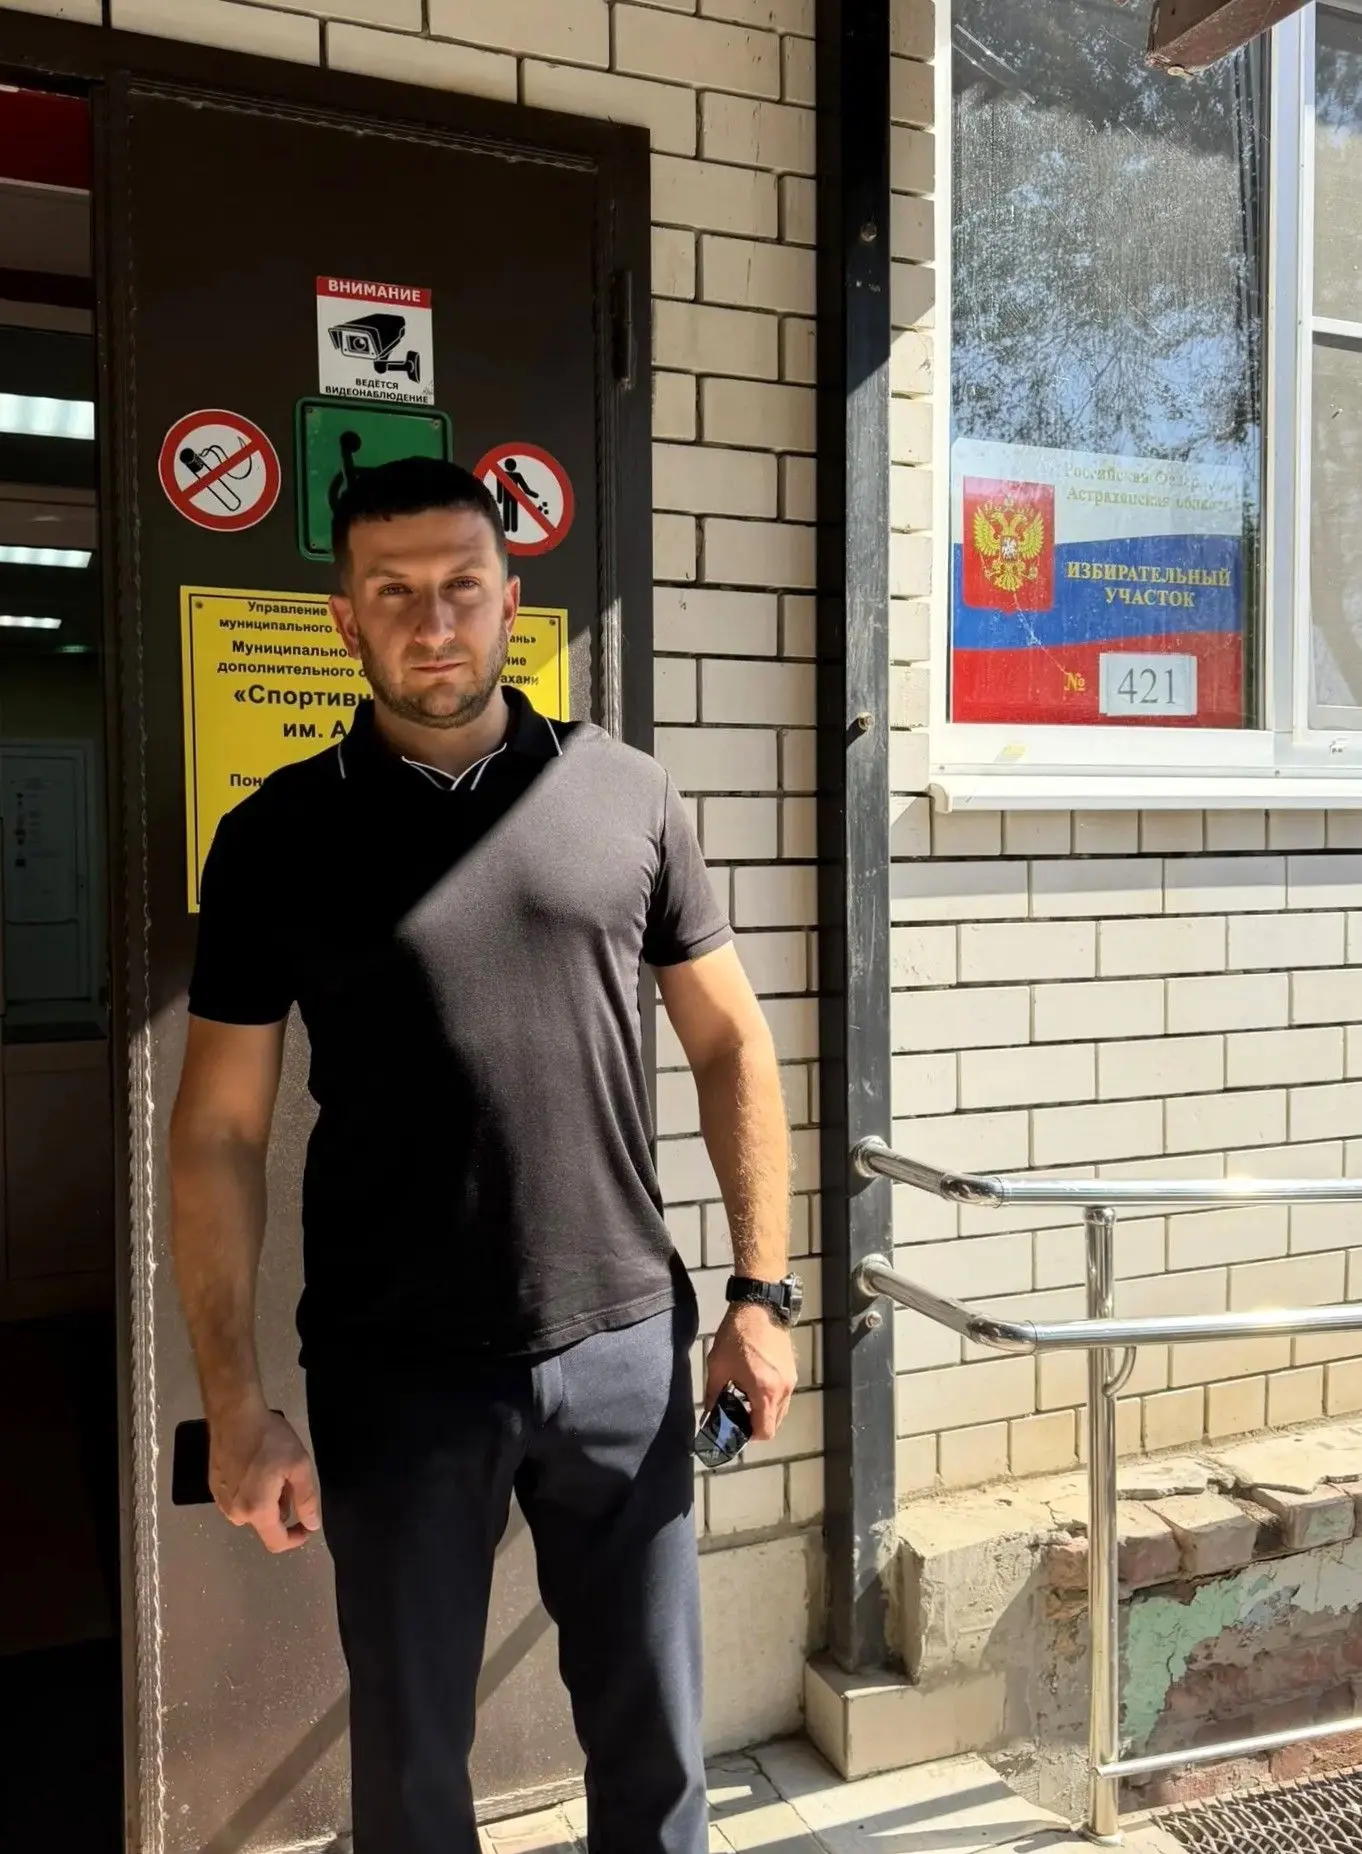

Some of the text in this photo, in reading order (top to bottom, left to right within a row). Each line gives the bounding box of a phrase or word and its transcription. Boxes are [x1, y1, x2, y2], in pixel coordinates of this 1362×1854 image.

[328, 279, 421, 302] ВНИМАНИЕ
[325, 386, 428, 403] ВИДЕОНАБЛЮДЕНИЕ
[1066, 561, 1232, 588] ИЗБИРАТЕЛЬНЫЙ
[1105, 587, 1196, 607] УЧАСТОК
[248, 601, 327, 616] Управление
[219, 618, 332, 633] муниципального
[232, 640, 349, 658] Муниципально
[217, 662, 354, 678] дополнительного
[1064, 668, 1177, 704] № 421
[283, 721, 324, 738] им.
